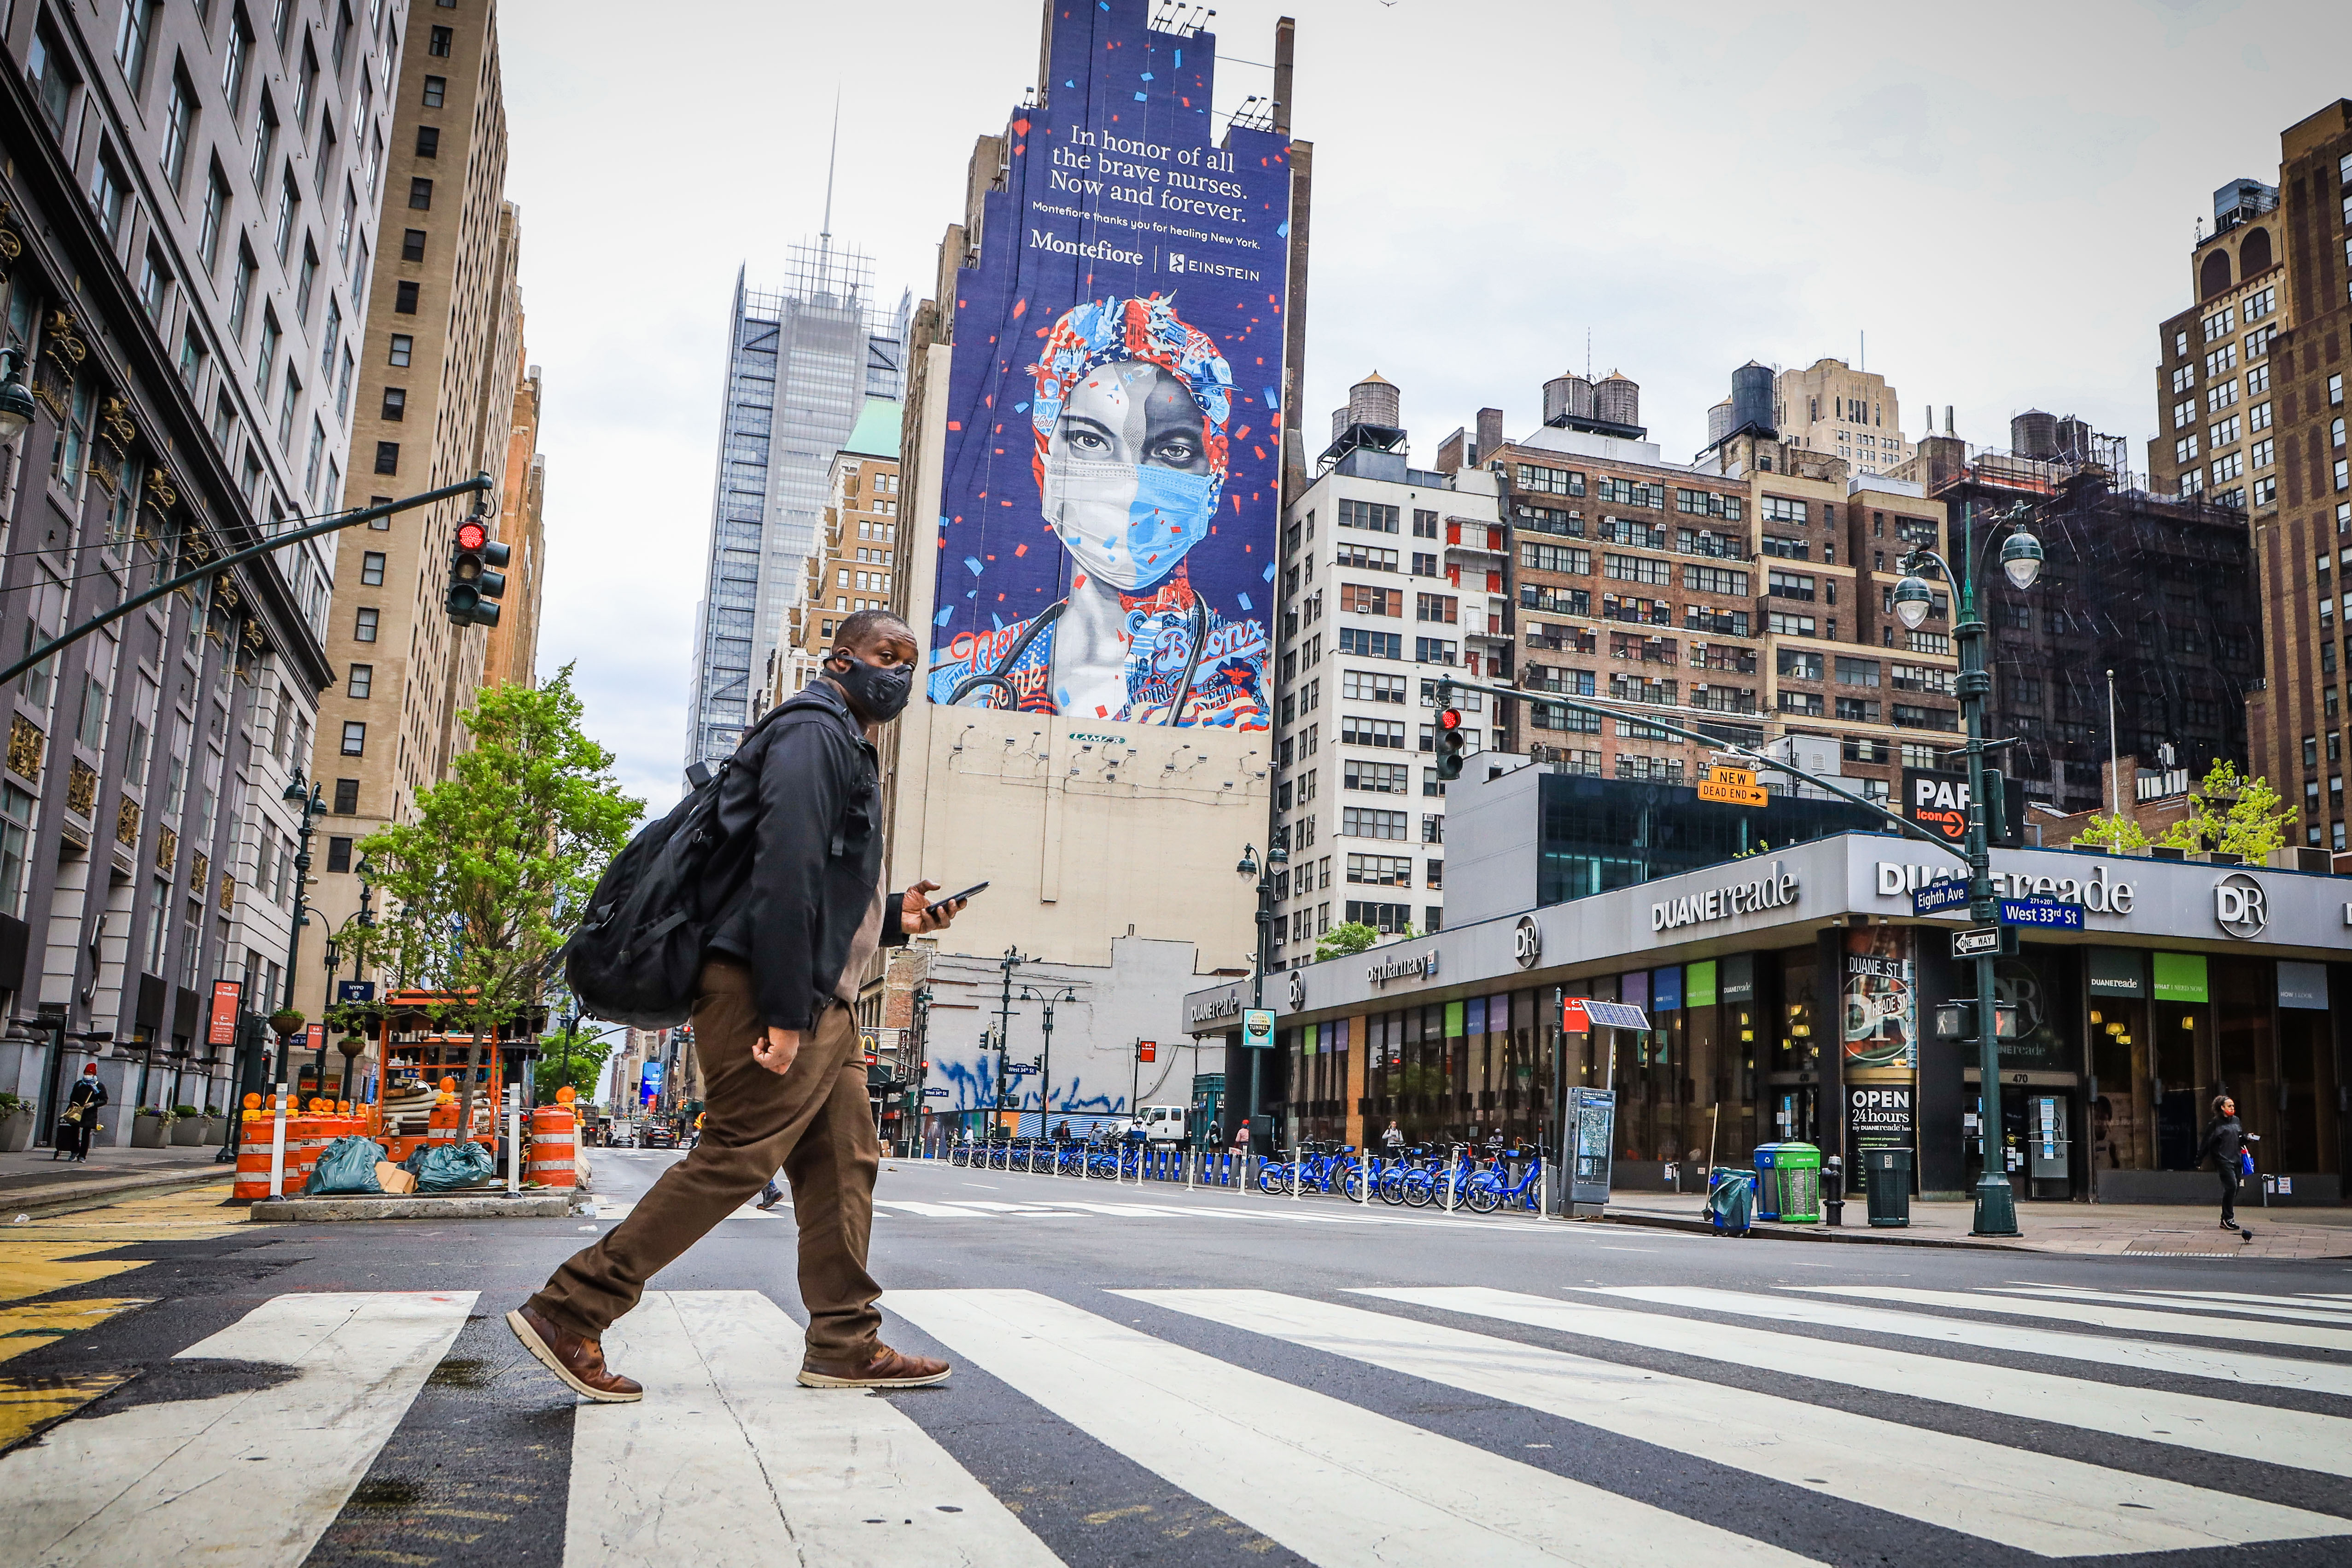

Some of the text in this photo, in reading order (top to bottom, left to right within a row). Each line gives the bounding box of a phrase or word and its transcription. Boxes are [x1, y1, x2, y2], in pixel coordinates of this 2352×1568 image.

[1070, 125, 1235, 174] In honor of all
[1053, 146, 1248, 200] the brave nurses.
[1050, 169, 1247, 223] Now and forever.
[1033, 201, 1261, 250] Montefiore thanks you for healing New York.
[1029, 229, 1144, 266] Montefiore
[1189, 260, 1260, 282] EINSTEIN
[1036, 402, 1057, 418] NY
[1032, 415, 1054, 427] Hero
[1153, 618, 1266, 675] Bonx
[1720, 771, 1746, 785] NEW
[1704, 786, 1746, 799] DEAD END
[1916, 808, 1943, 822] icon
[1918, 888, 1964, 909] Eighth Ave
[2215, 885, 2269, 925] DR
[2006, 905, 2077, 924] West 33rd St
[1515, 925, 1540, 958] DR
[1960, 936, 1991, 948] ONE WAY
[1378, 955, 1427, 989] pharmacy
[1849, 956, 1899, 977] DUANE ST
[1872, 993, 1907, 1018] READE ST
[899, 1031, 907, 1074] PIZZERIA
[2013, 1073, 2028, 1083] 470
[1852, 1090, 1910, 1108] OPEN
[1852, 1108, 1909, 1123] 24 hours
